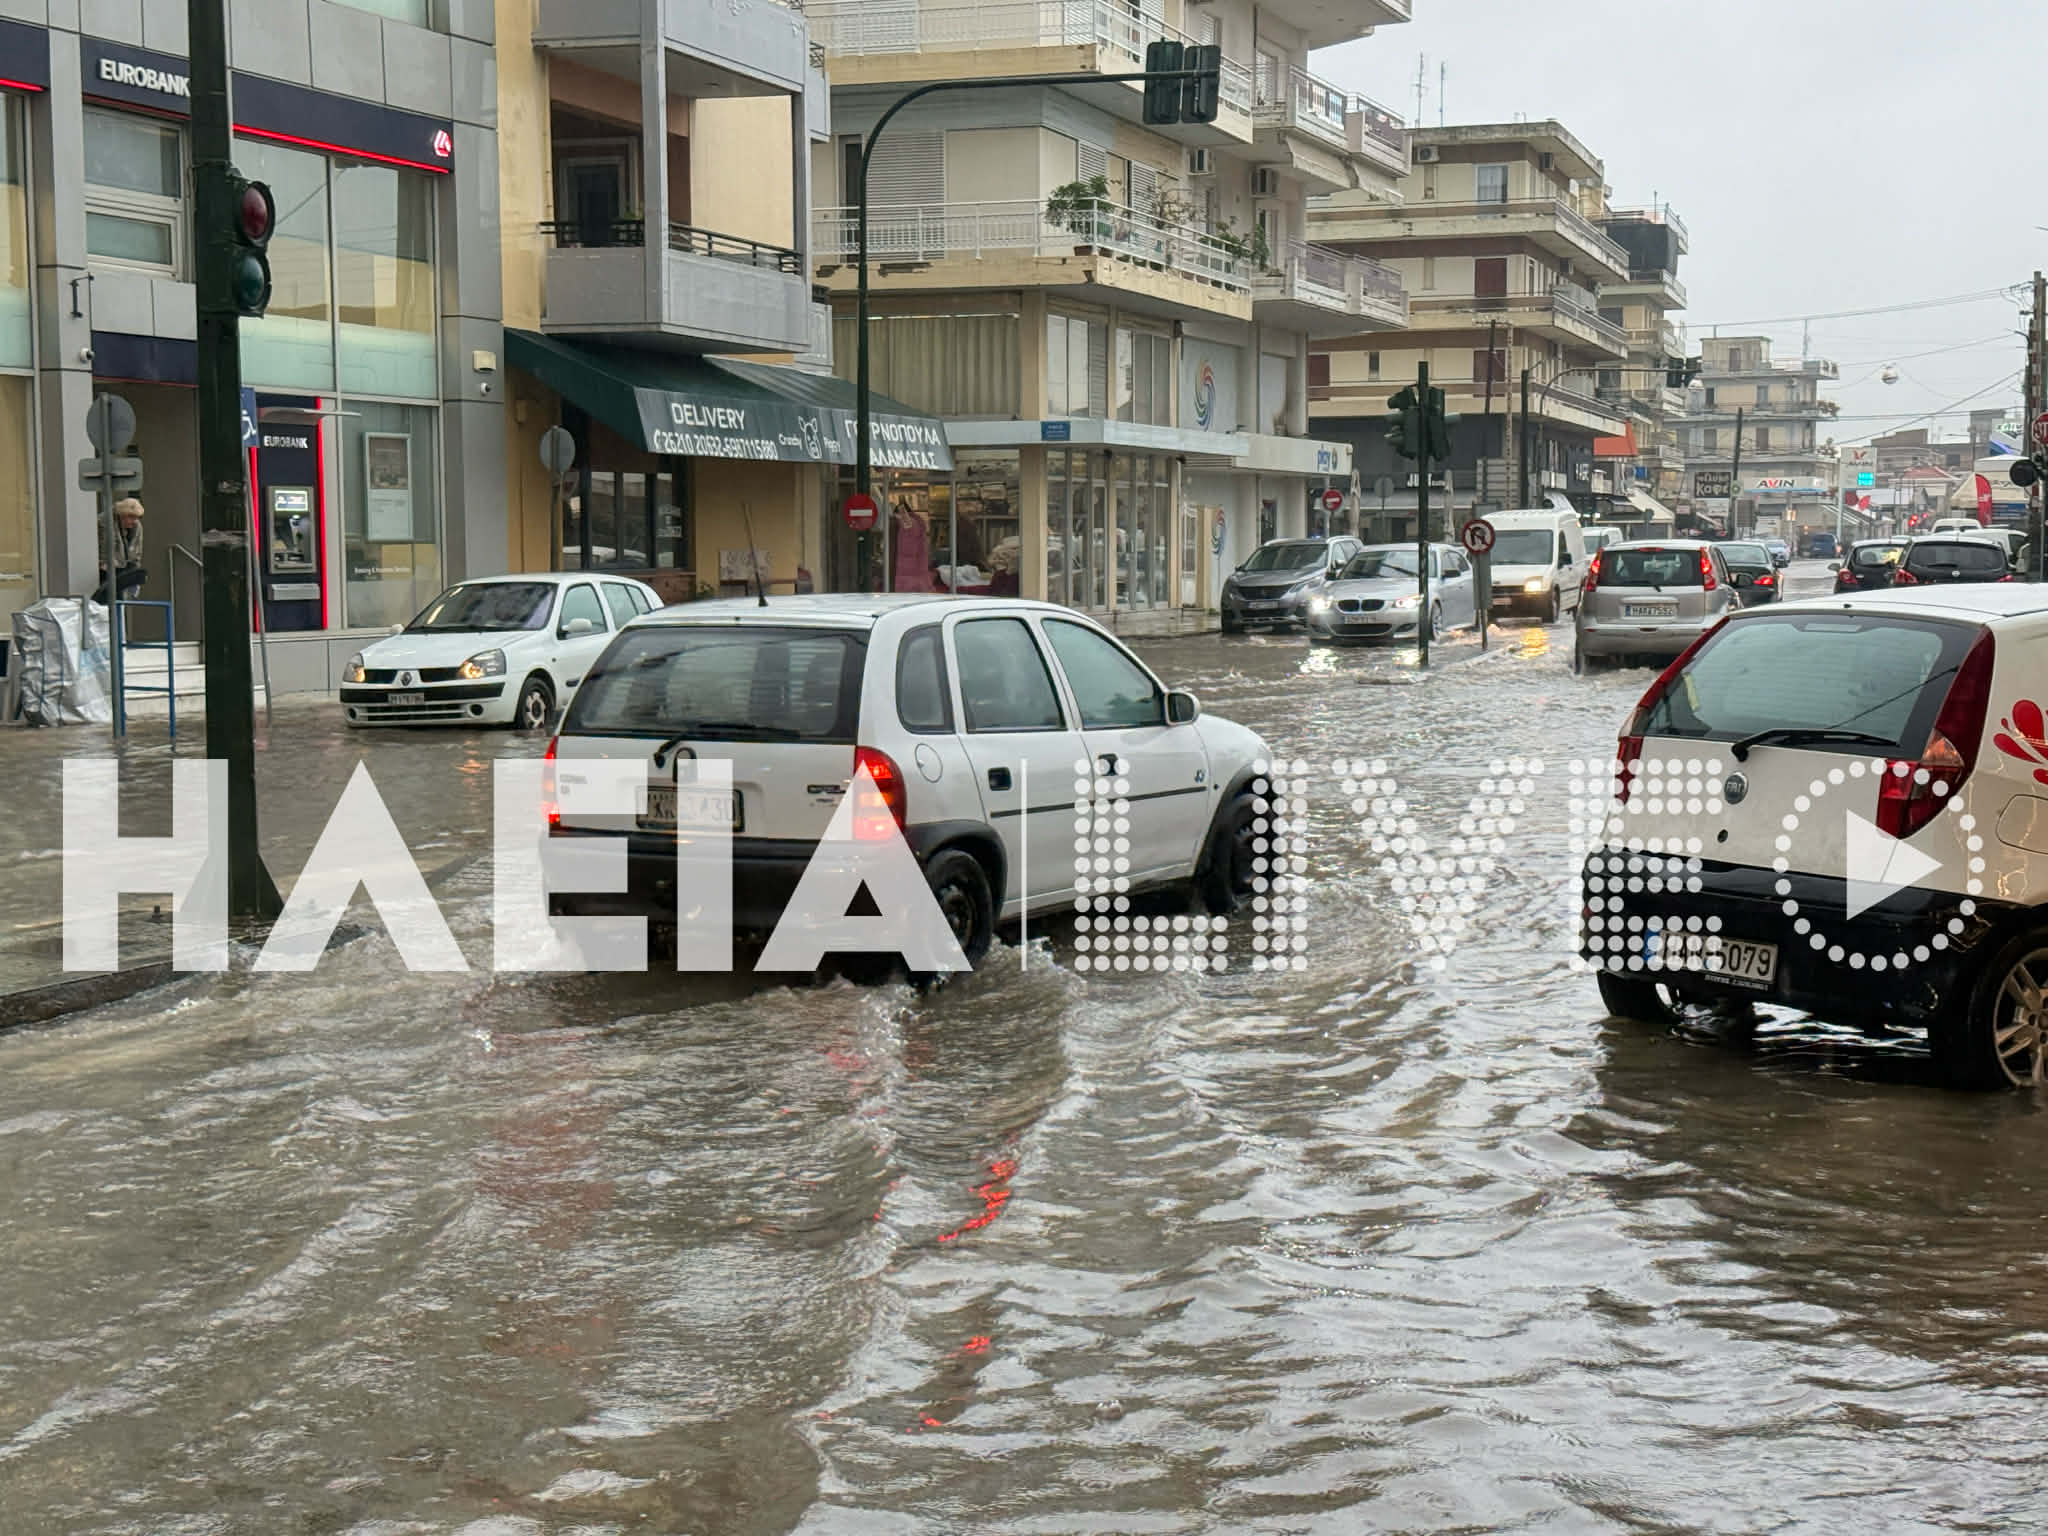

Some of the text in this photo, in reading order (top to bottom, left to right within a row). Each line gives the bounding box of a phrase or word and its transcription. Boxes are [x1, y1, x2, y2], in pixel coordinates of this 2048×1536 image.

[100, 58, 191, 97] EUROBANK
[671, 402, 745, 430] DELIVERY
[263, 435, 309, 449] EUROBANK
[845, 419, 941, 446] ΓΡΝΟΠΟΥΛΑ
[869, 447, 939, 470] ΑΛΑΜΑΤΑΣ
[1757, 479, 1795, 489] AVIN
